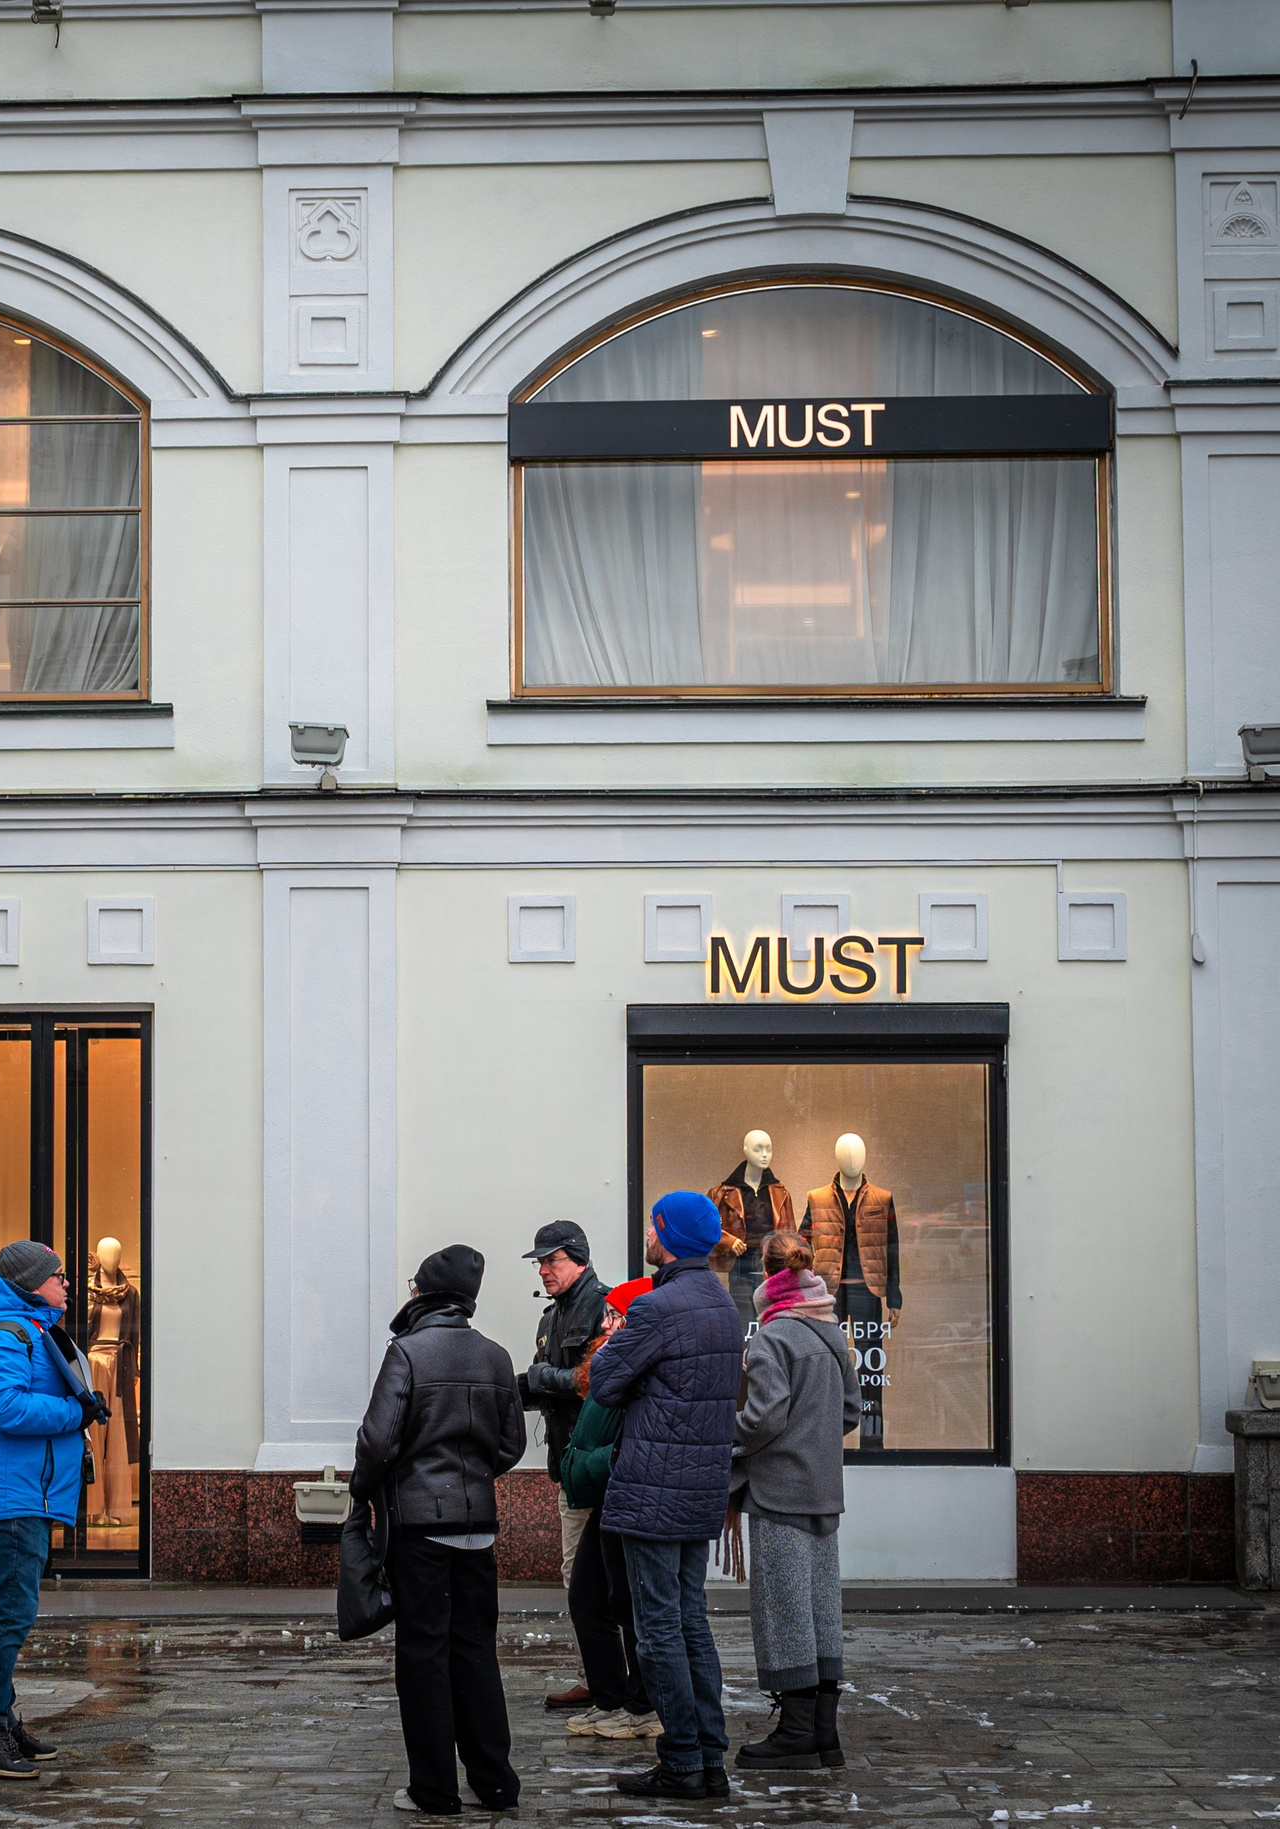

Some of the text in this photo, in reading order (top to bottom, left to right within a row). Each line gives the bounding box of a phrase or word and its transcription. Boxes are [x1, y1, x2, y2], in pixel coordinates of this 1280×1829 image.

[731, 403, 886, 448] MUST
[711, 936, 925, 995] MUST
[744, 1321, 892, 1342] Д ЯБРЯ
